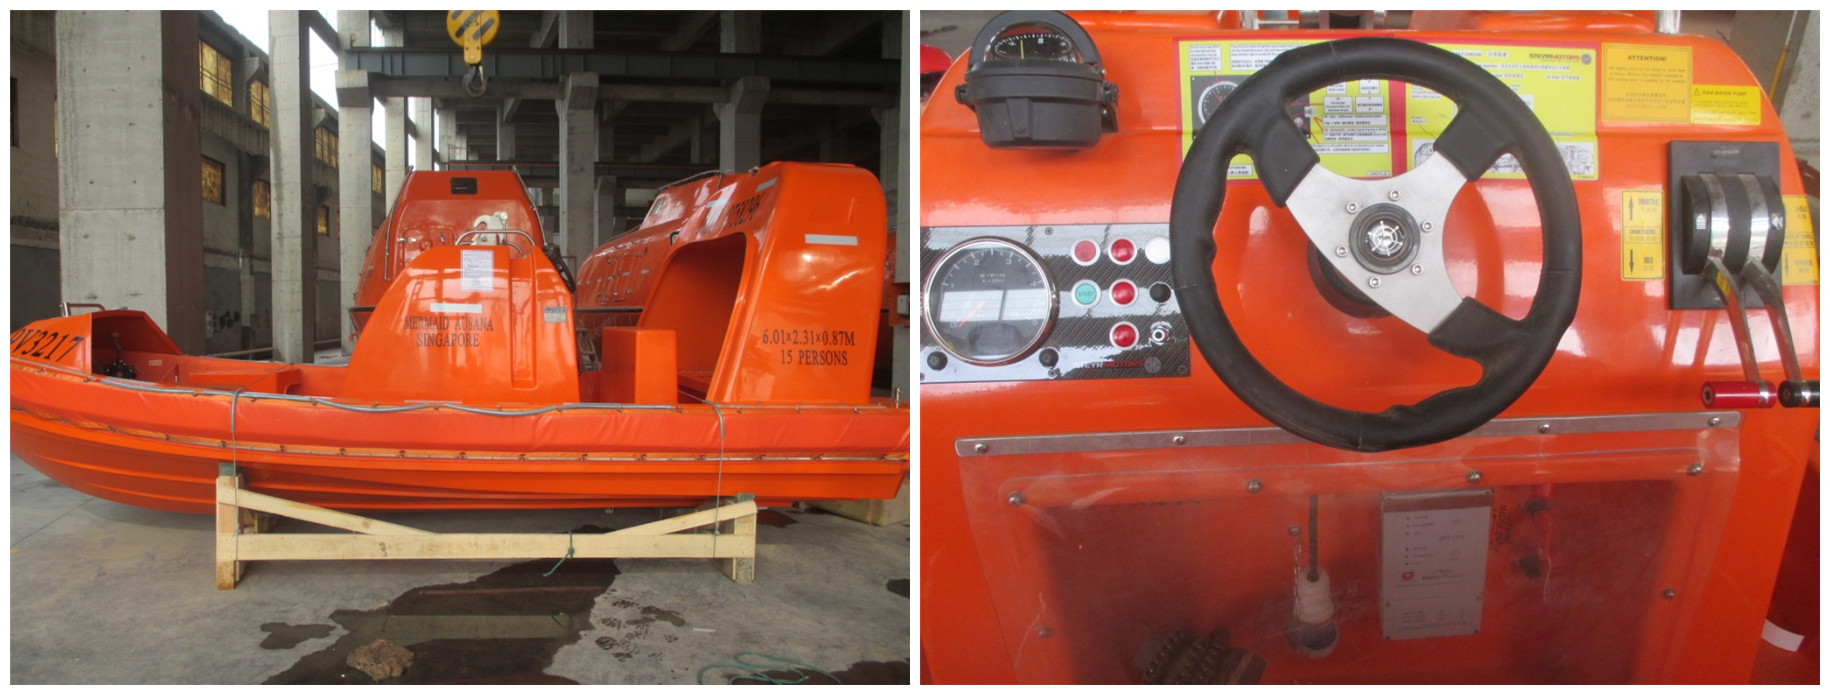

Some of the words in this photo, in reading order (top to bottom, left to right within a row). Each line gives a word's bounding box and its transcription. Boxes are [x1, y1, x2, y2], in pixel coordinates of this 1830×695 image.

[404, 315, 450, 331] MERMAID
[454, 316, 494, 332] AUSANA
[416, 332, 480, 348] SINGAPORE
[781, 349, 793, 365] 15
[798, 349, 848, 366] PERSONS
